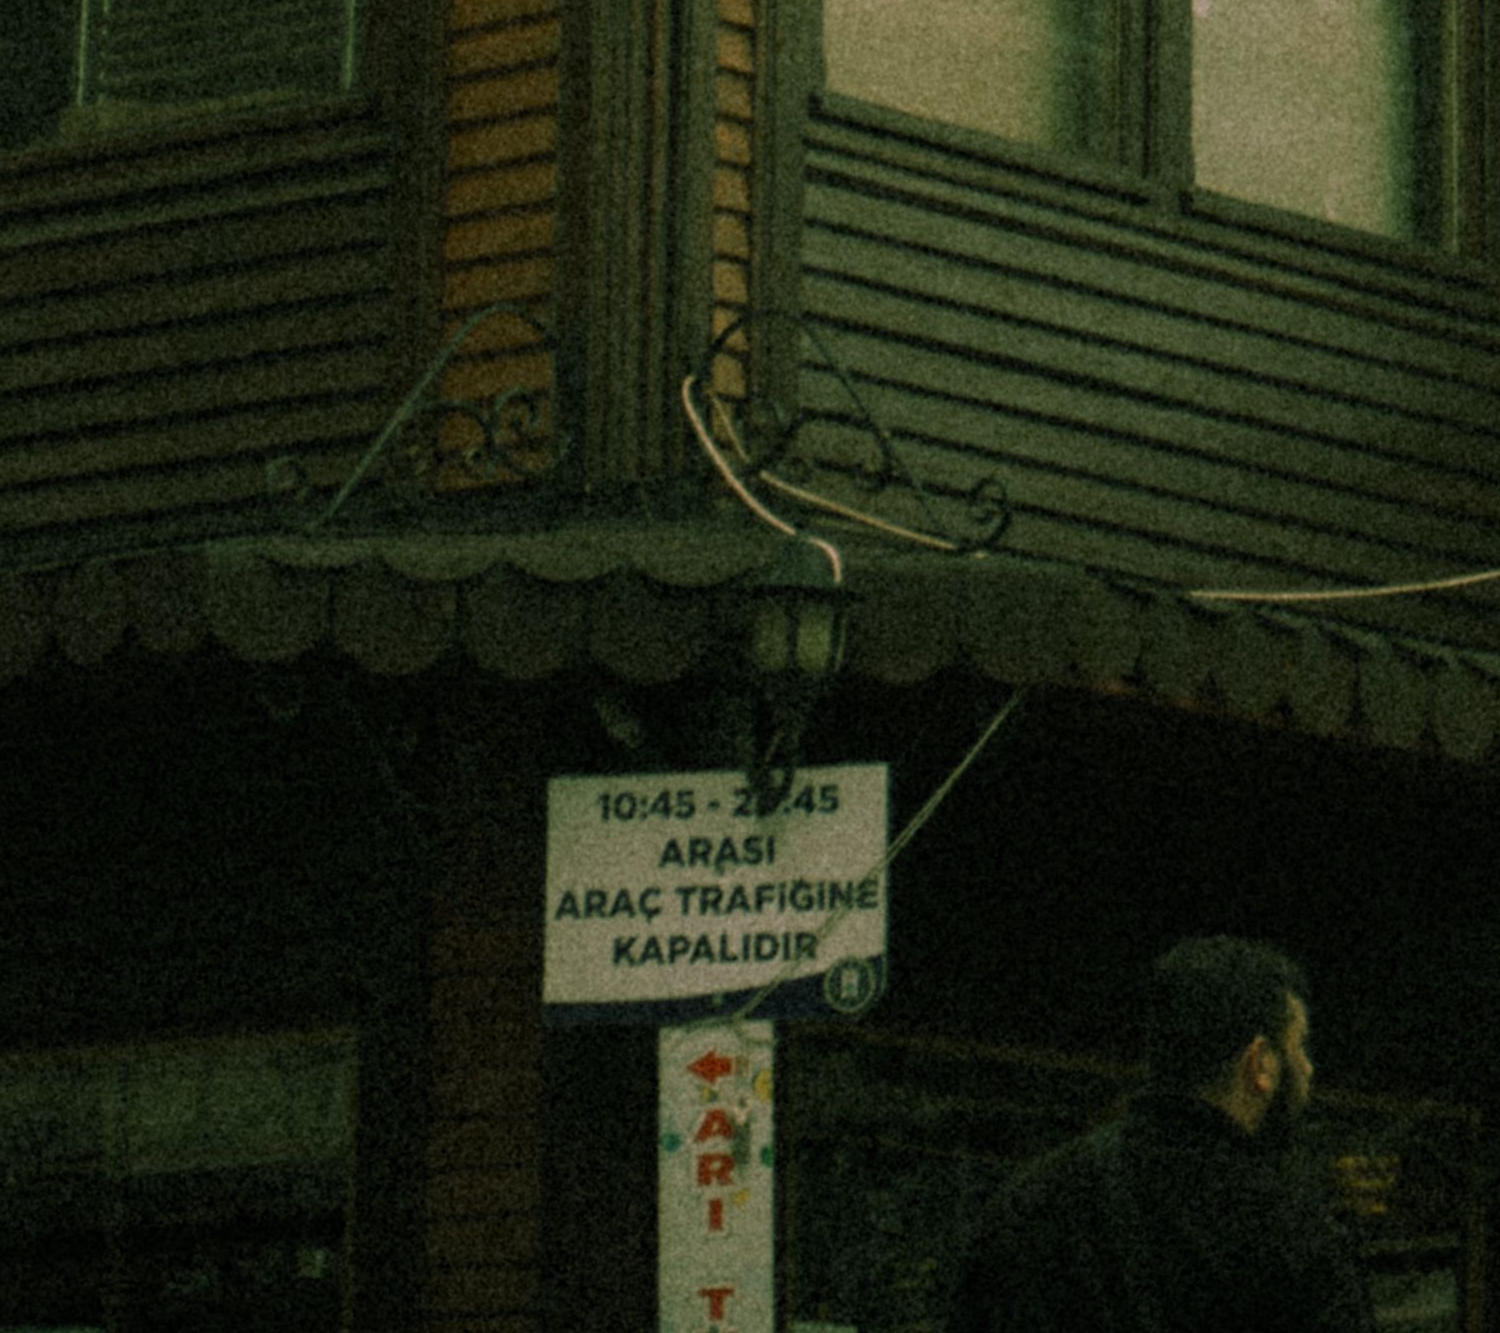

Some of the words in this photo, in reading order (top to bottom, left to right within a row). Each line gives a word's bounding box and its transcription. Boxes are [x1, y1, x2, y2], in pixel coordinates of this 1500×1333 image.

[599, 790, 696, 822] 10:45
[733, 784, 840, 818] 2:45
[659, 836, 776, 869] ARASI
[555, 888, 663, 923] ARAÇ
[612, 930, 819, 967] KAPALIDIR
